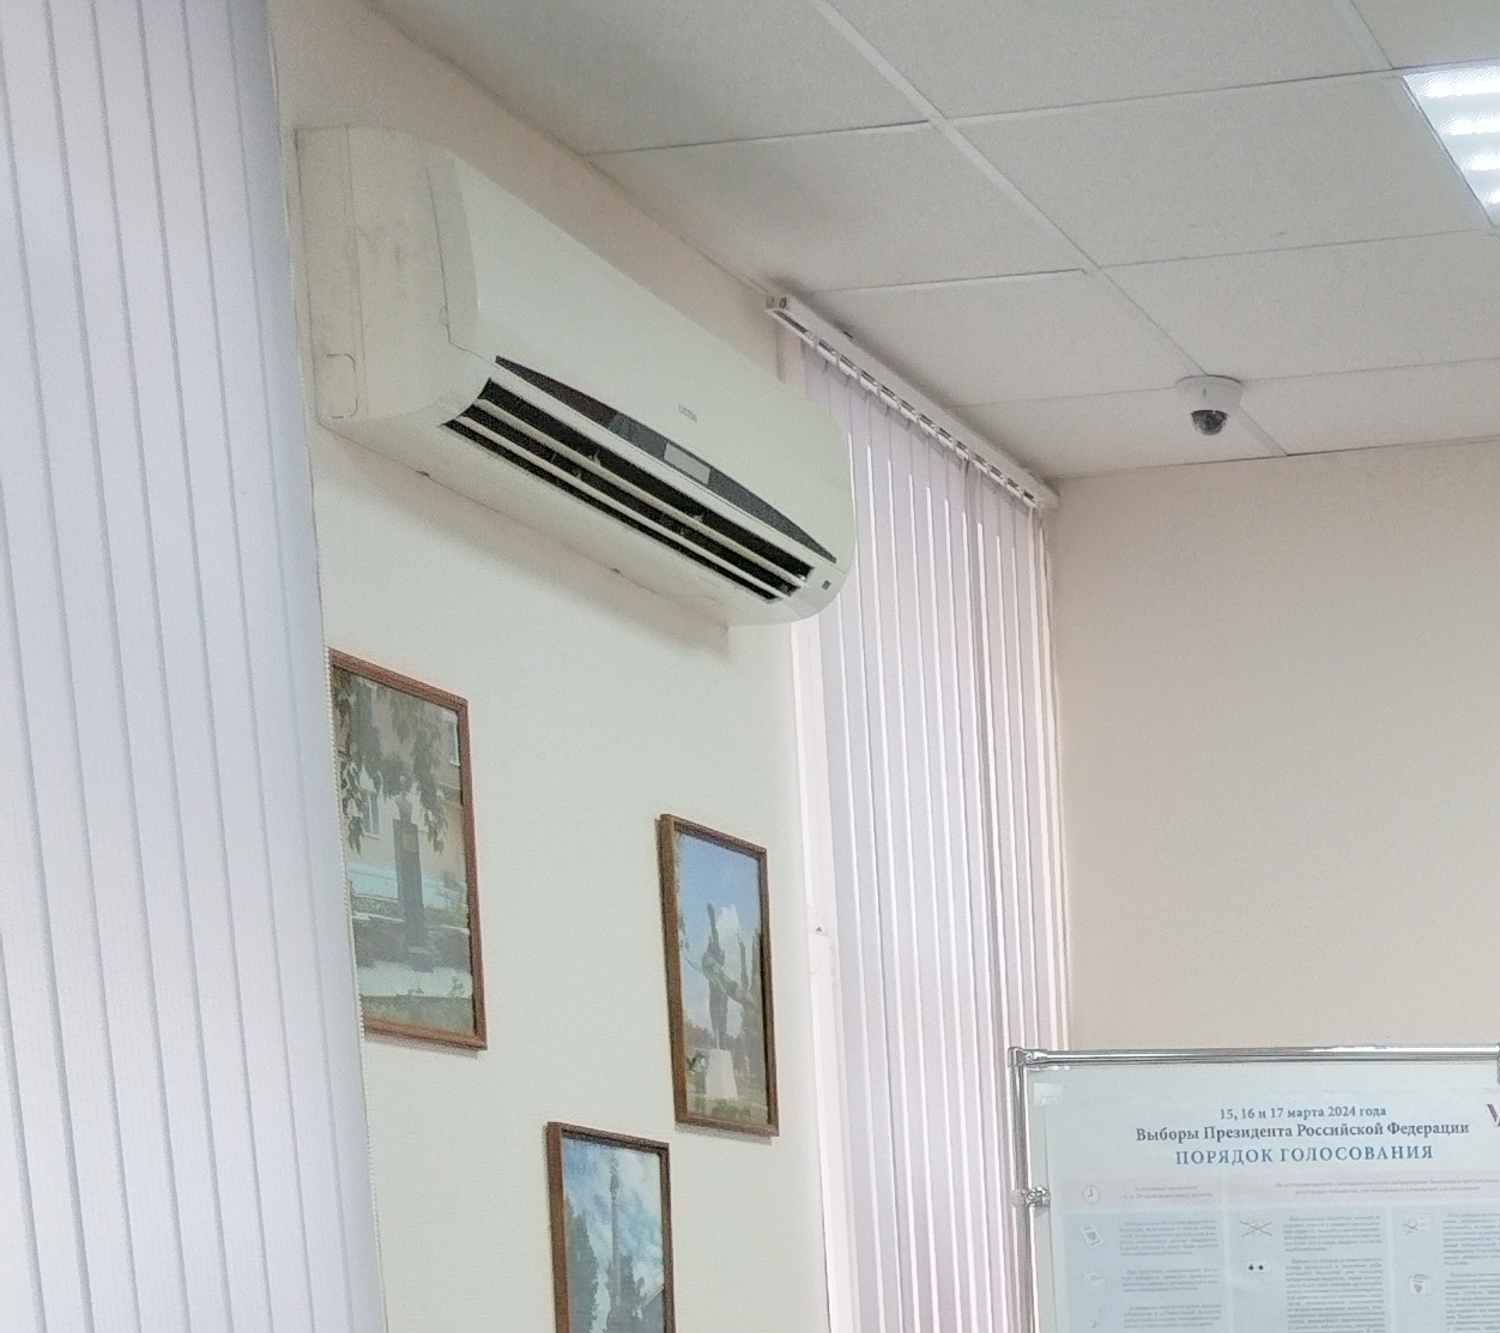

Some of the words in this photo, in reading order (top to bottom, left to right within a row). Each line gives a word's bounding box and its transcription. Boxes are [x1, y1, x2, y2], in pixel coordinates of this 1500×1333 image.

[1220, 1108, 1238, 1121] 15,
[1241, 1108, 1255, 1119] 16
[1258, 1110, 1266, 1119] и
[1271, 1108, 1284, 1119] 17
[1287, 1108, 1325, 1121] марта
[1328, 1106, 1356, 1118] 2024
[1359, 1107, 1387, 1118] года
[1136, 1126, 1199, 1144] Выборы
[1203, 1124, 1293, 1143] Президента
[1297, 1122, 1384, 1138] Российской
[1387, 1121, 1470, 1138] Федерации
[1175, 1148, 1273, 1166] ПОРЯДОК
[1280, 1145, 1434, 1163] ГОЛОСОВАНИЯ
